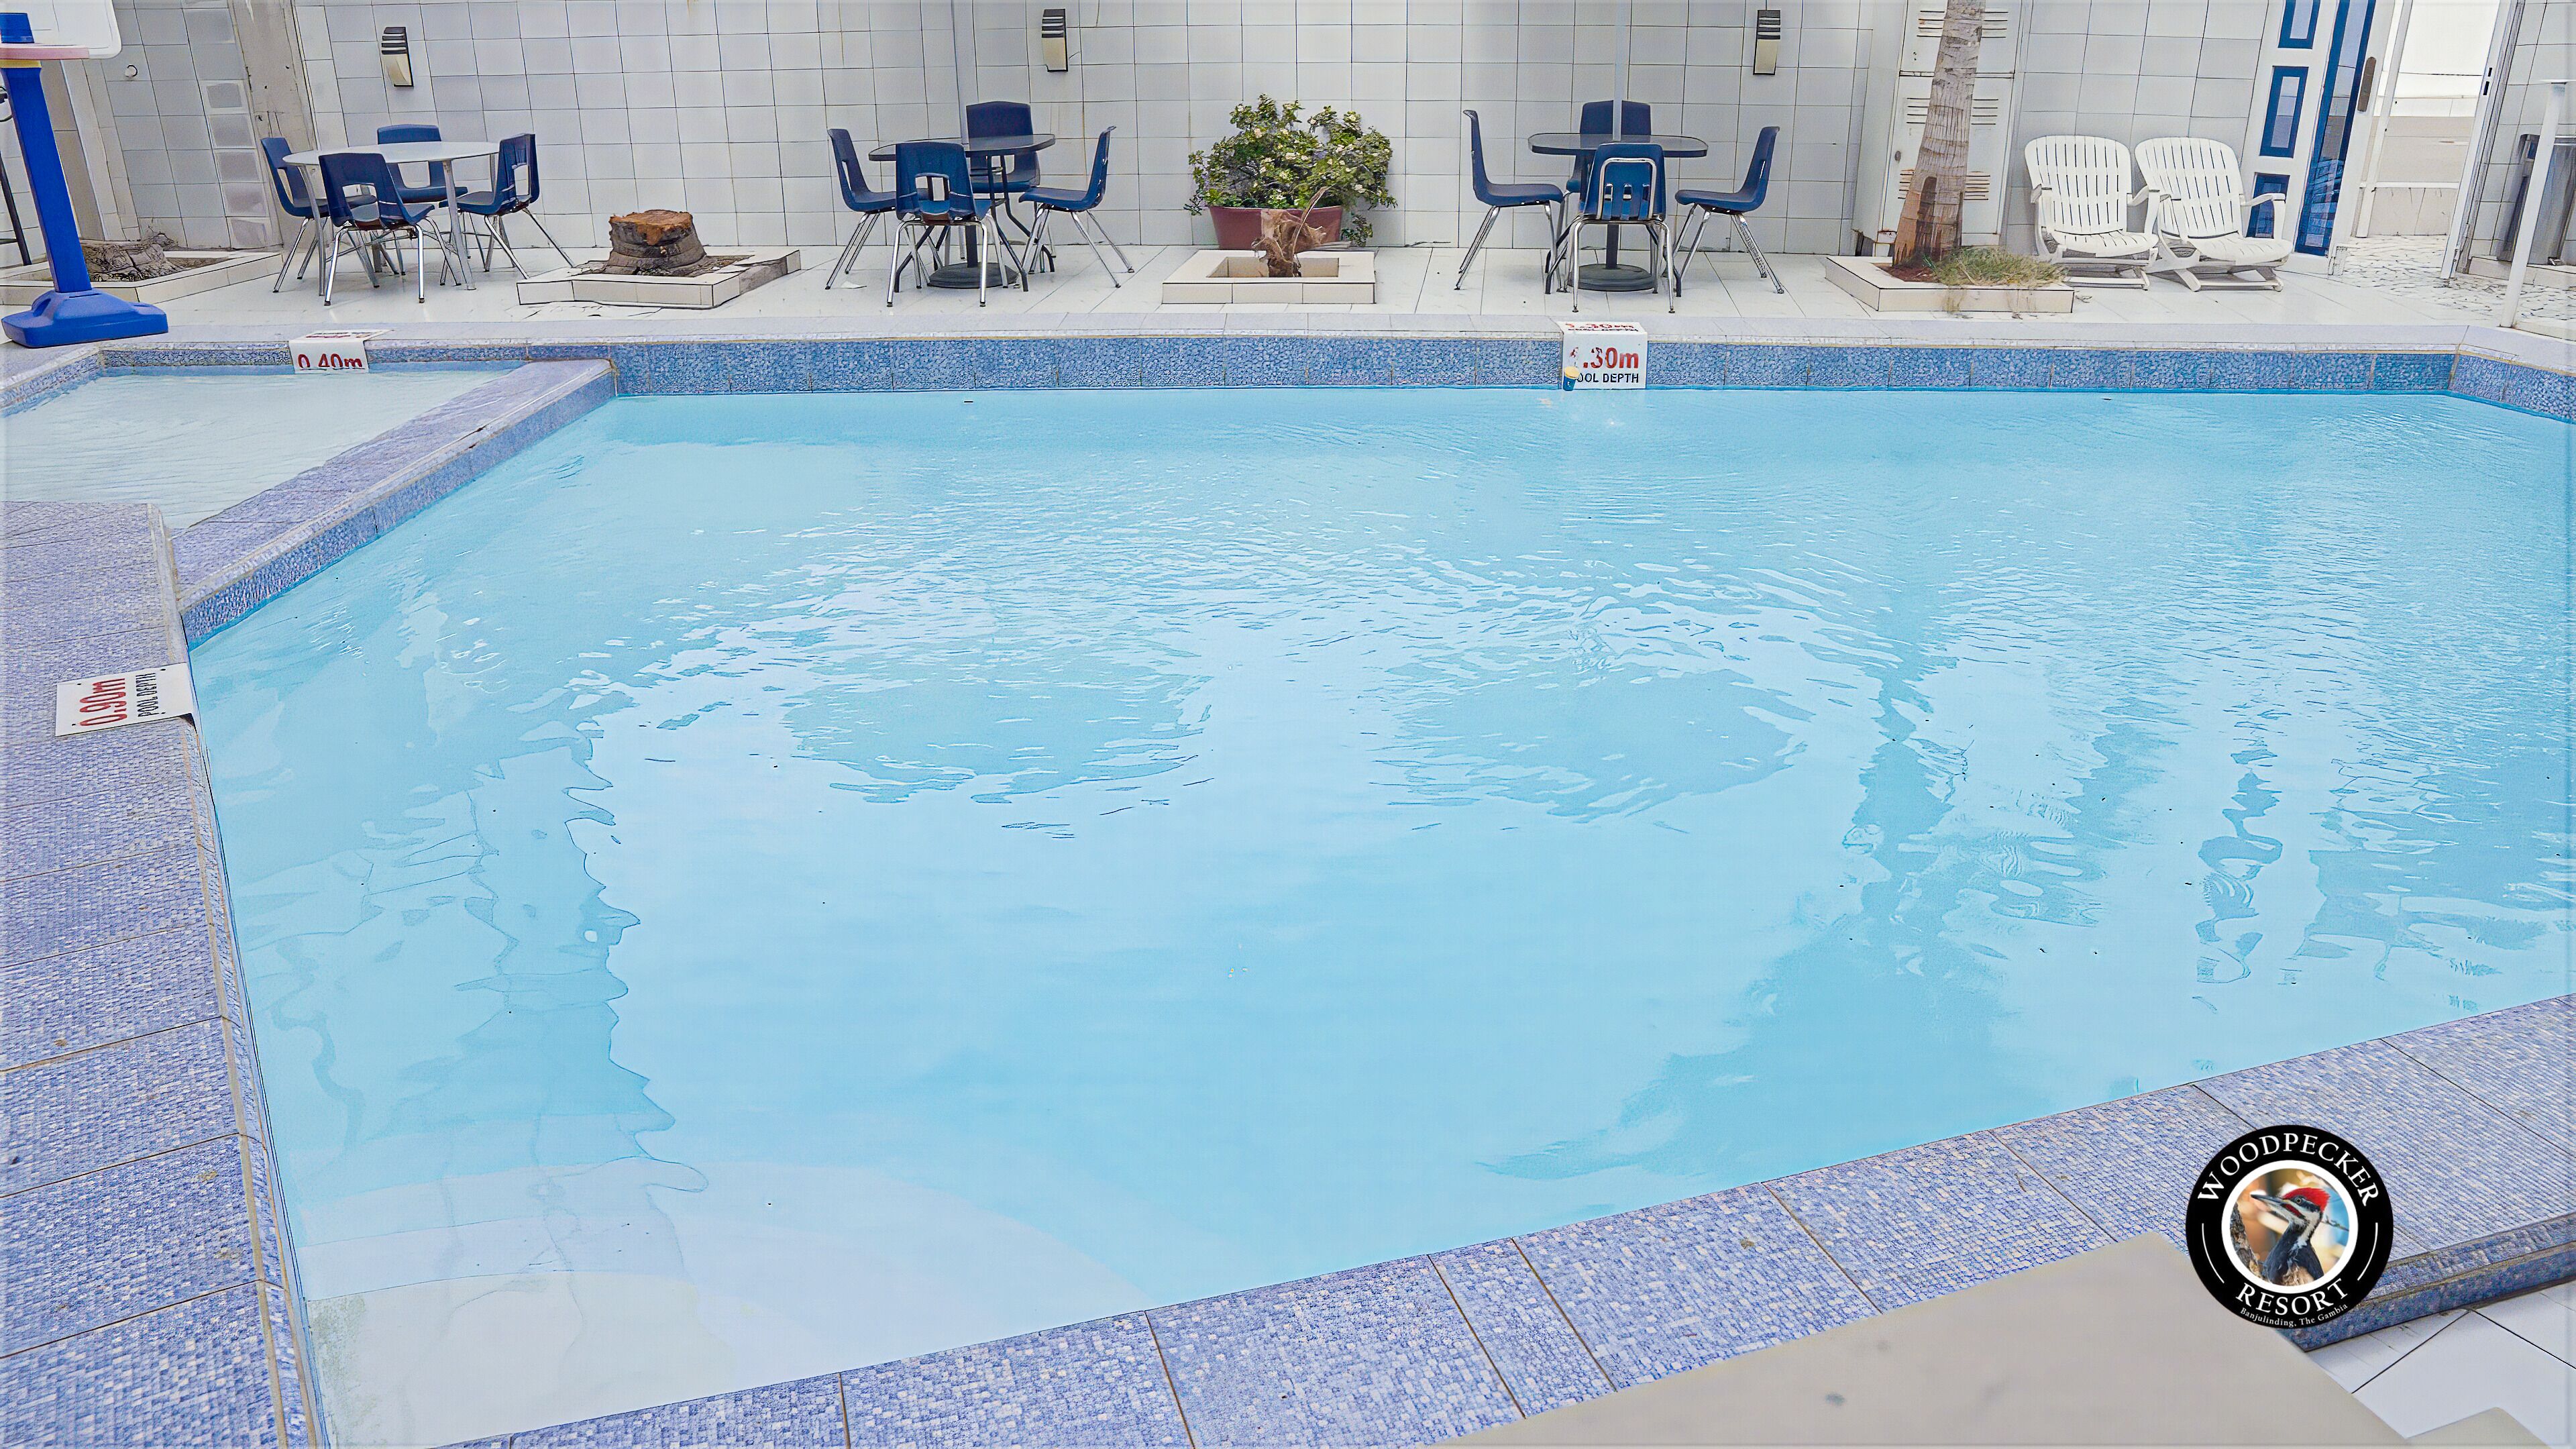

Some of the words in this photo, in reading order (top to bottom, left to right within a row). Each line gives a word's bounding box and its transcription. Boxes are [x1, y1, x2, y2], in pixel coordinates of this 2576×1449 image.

[298, 354, 363, 368] 040m
[1576, 373, 1599, 383] OOL
[1603, 373, 1639, 383] DEPTH
[136, 673, 157, 697] DEPTH
[79, 678, 127, 727] 0.90m
[136, 696, 159, 717] POOL
